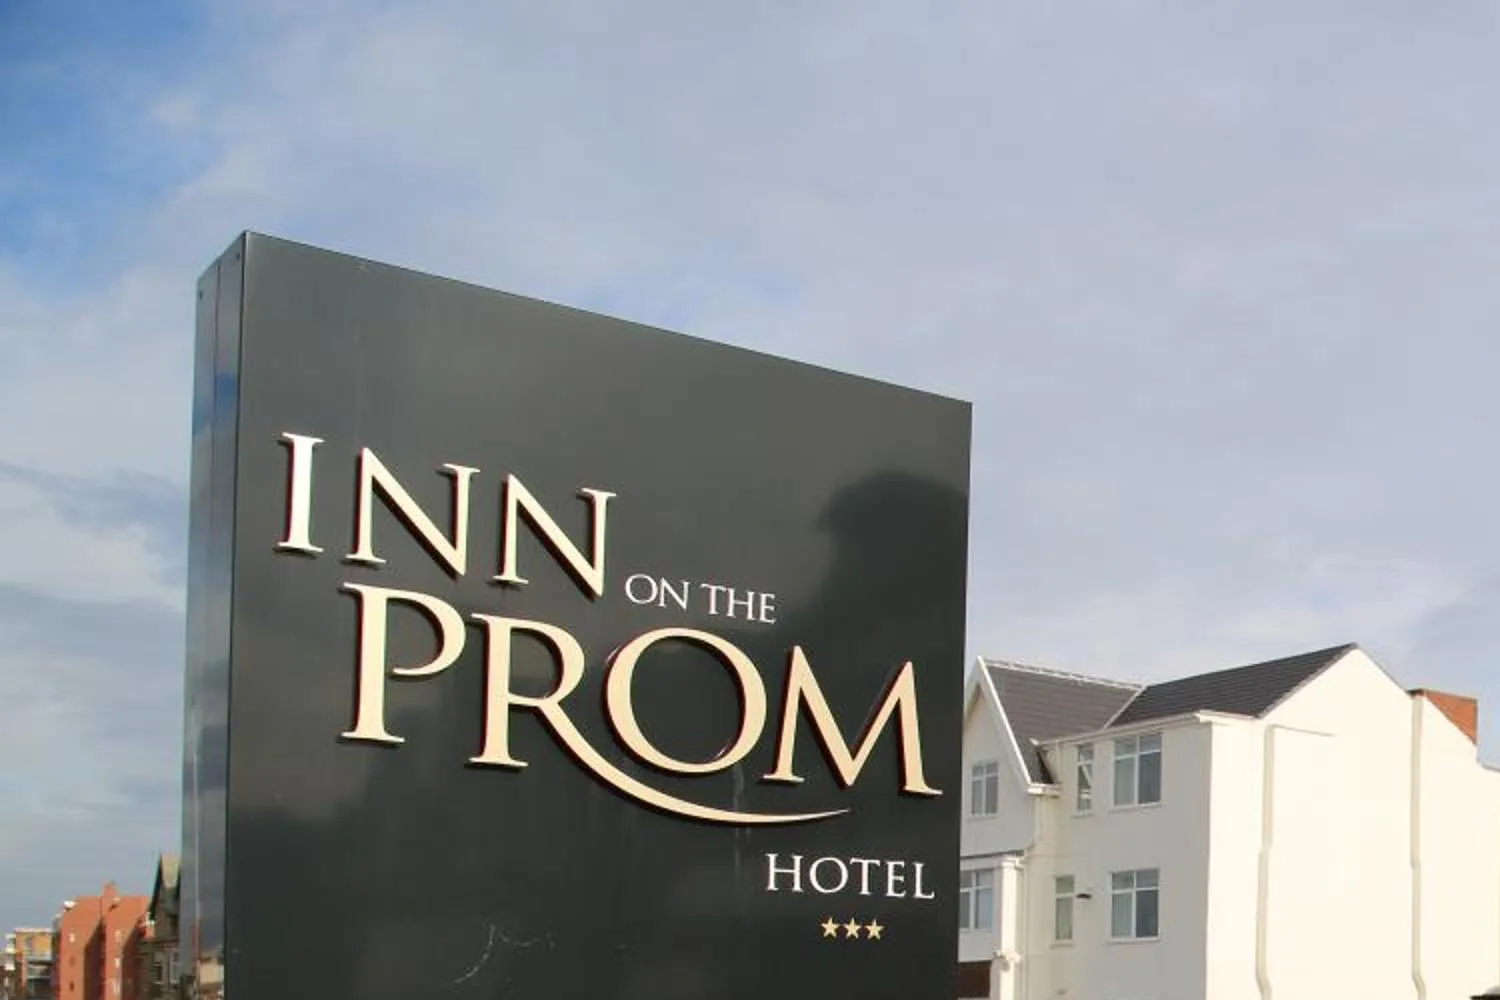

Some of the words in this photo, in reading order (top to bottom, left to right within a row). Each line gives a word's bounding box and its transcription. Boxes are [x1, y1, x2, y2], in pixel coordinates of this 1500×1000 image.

[275, 431, 617, 597] INN
[624, 573, 691, 611] ON
[700, 582, 777, 625] THE
[338, 581, 944, 826] PROM
[765, 852, 936, 900] HOTEL
